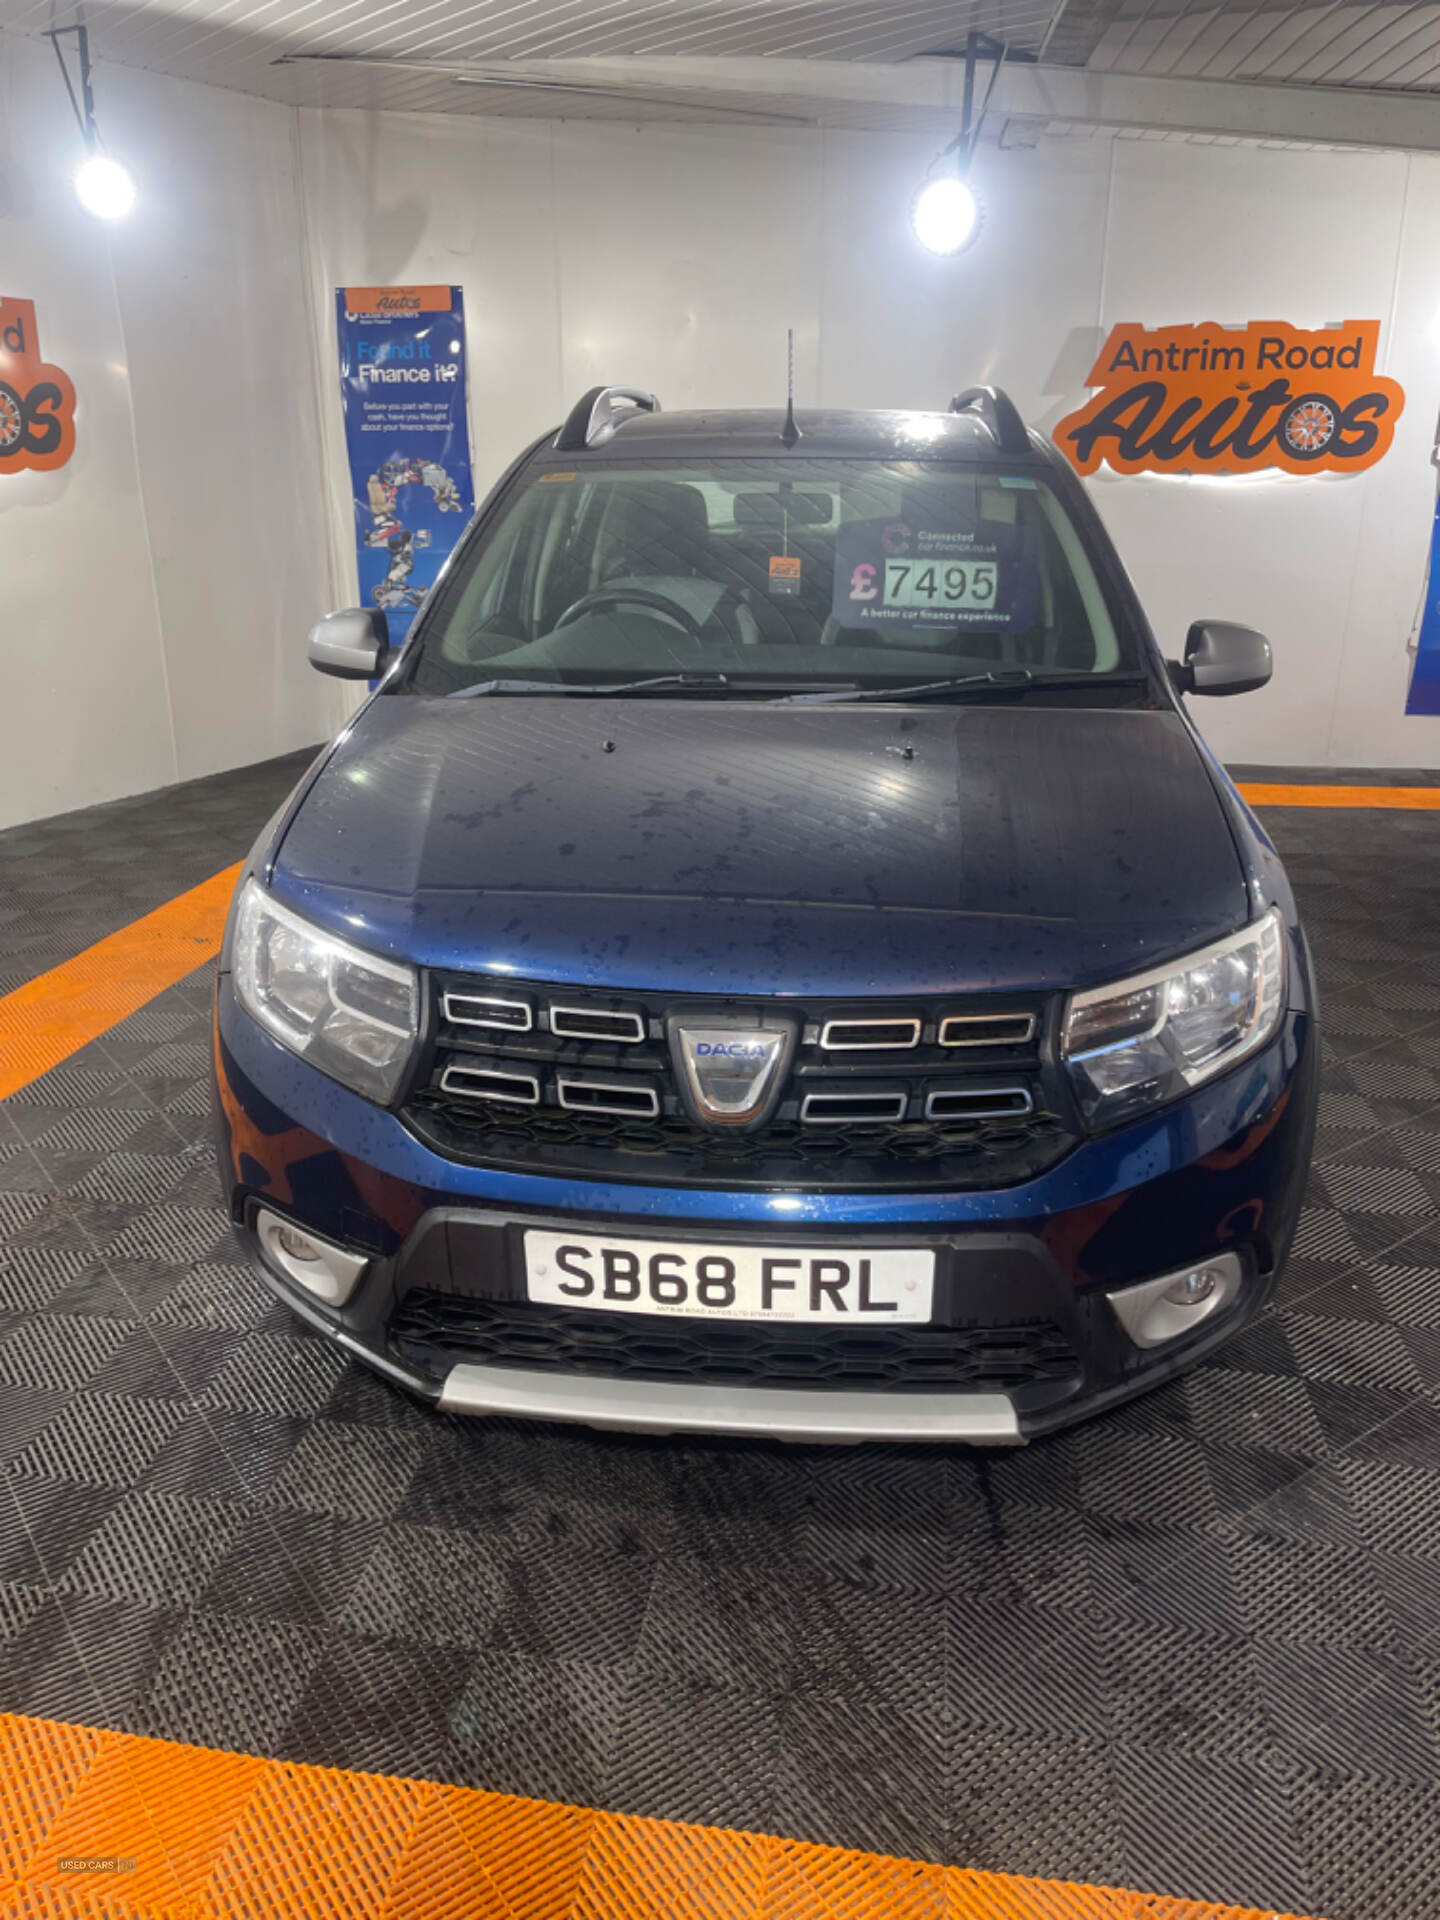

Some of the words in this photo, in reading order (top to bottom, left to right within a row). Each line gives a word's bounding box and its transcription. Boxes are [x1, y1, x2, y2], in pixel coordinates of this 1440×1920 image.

[357, 341, 414, 360] Found
[419, 341, 432, 360] it
[1108, 339, 1245, 372] Antrim
[1256, 337, 1362, 370] Road
[358, 364, 430, 383] Finance
[1066, 378, 1389, 462] Autos
[918, 531, 974, 542] Connected
[860, 608, 869, 617] A
[871, 608, 900, 619] better
[902, 611, 918, 620] car
[920, 609, 955, 620] finance
[957, 610, 1011, 622] experience
[696, 1043, 766, 1058] DACIA
[555, 1245, 736, 1307] SB68
[761, 1258, 898, 1312] FRL
